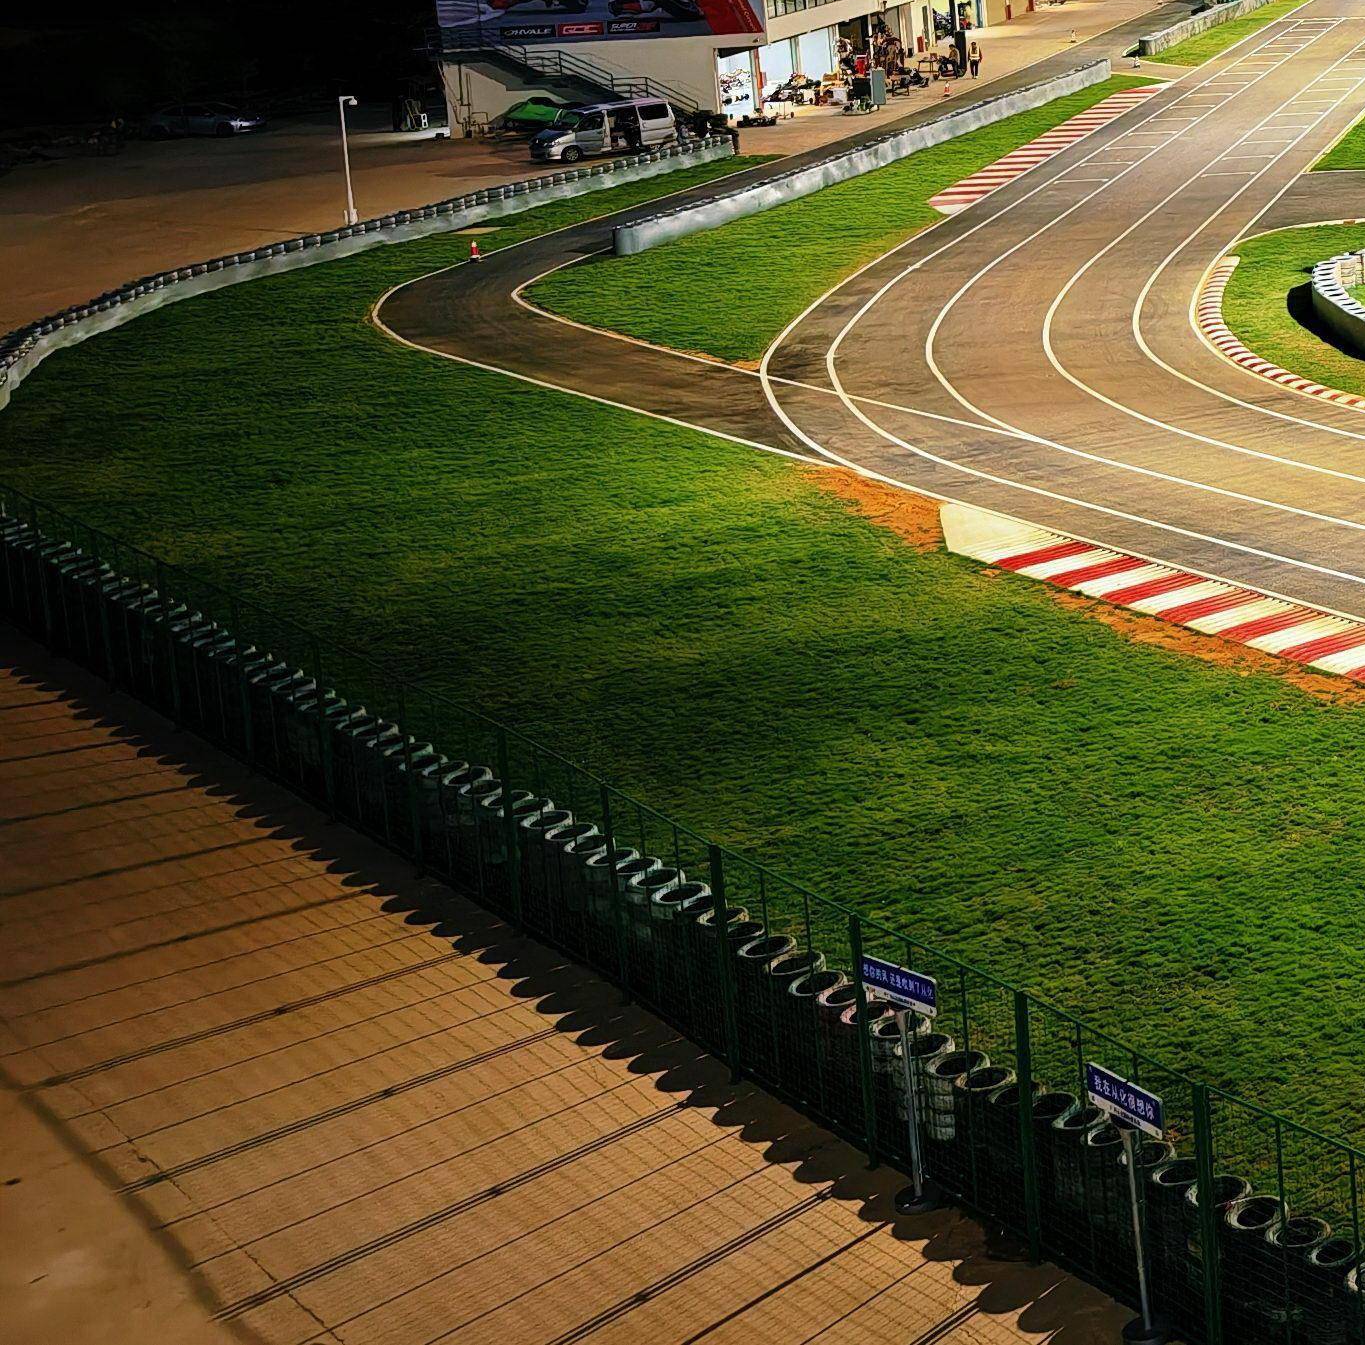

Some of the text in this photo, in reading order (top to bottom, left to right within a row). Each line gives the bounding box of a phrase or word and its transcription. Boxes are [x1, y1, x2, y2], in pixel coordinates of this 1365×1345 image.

[504, 28, 552, 37] OHVALE
[1094, 1074, 1155, 1121] 我在从化很想你
